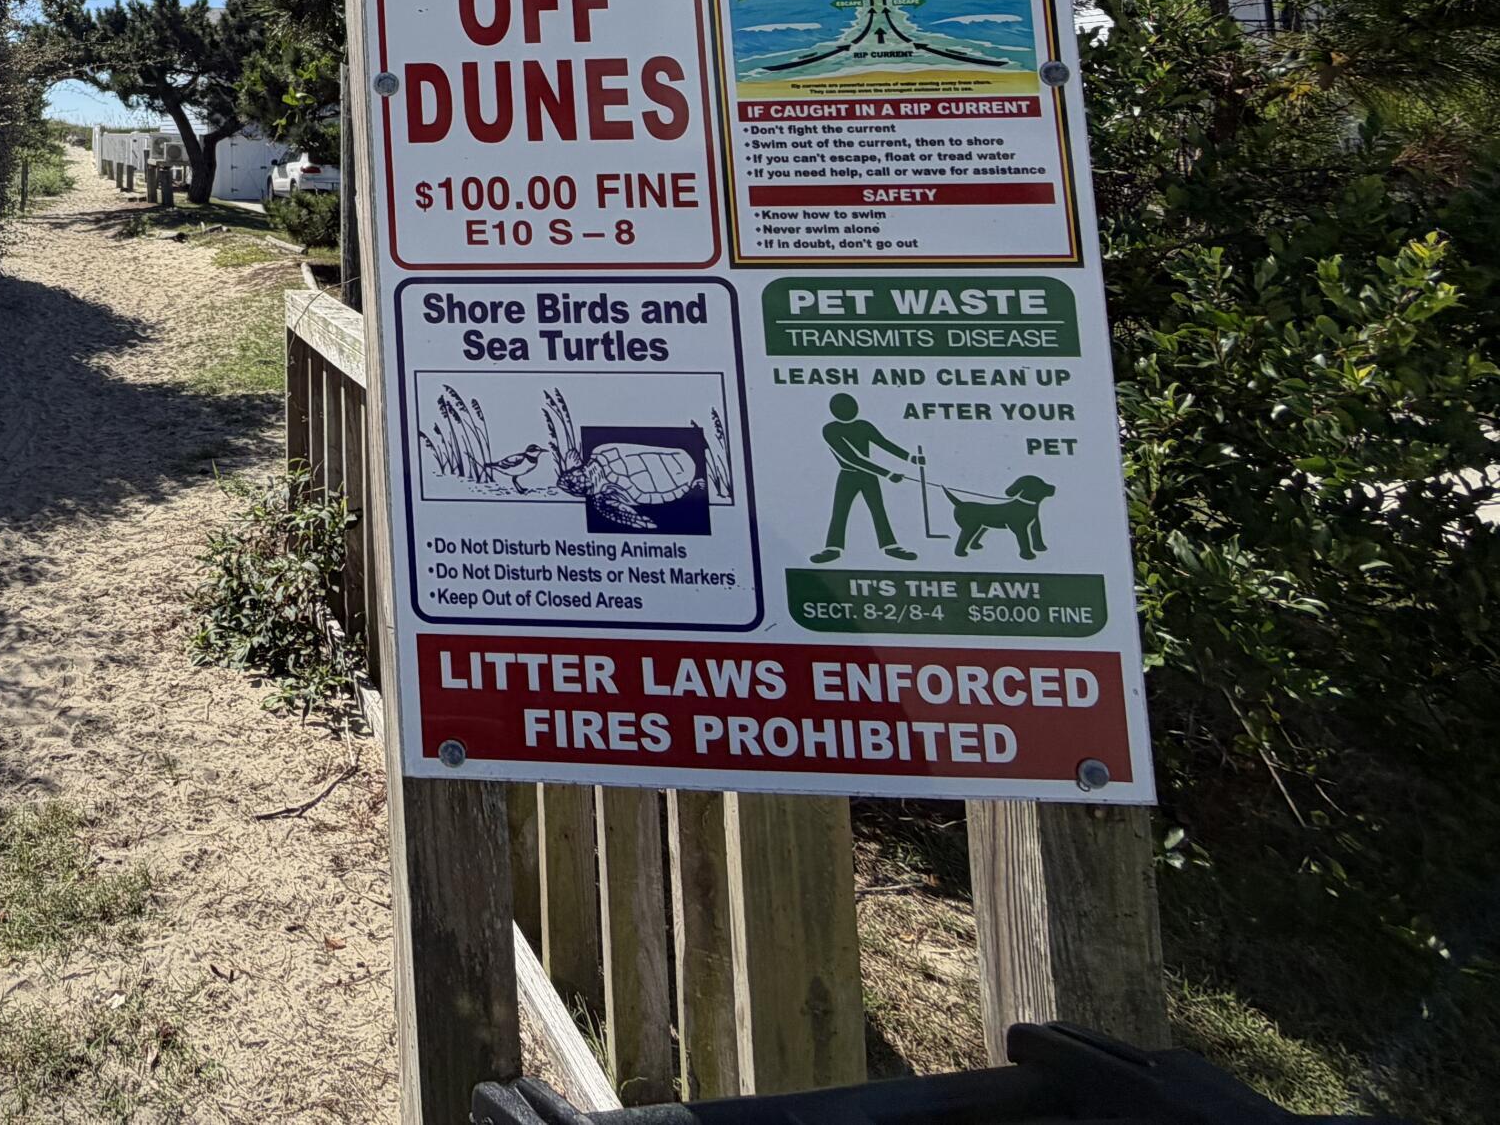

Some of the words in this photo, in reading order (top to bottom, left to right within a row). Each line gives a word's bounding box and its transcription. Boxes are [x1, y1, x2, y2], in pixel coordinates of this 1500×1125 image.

[404, 56, 689, 143] DUNES
[747, 105, 764, 118] IF
[770, 104, 849, 118] CAUGHT
[855, 103, 875, 116] IN
[881, 103, 895, 116] A
[901, 103, 931, 115] RIP
[937, 101, 1030, 114] CURRENT
[751, 125, 784, 134] Don't
[788, 125, 818, 136] fight
[822, 125, 842, 133] the
[847, 124, 896, 133] current
[752, 140, 787, 149] Swim
[791, 140, 812, 148] out
[816, 139, 829, 148] of
[833, 139, 854, 147] the
[858, 138, 912, 148] current,
[915, 137, 945, 146] then
[948, 137, 962, 146] to
[966, 136, 1004, 146] shore
[753, 154, 762, 163] If
[766, 156, 789, 165] you
[793, 154, 825, 163] can't
[830, 154, 881, 164] escape,
[885, 152, 915, 161] float
[919, 153, 933, 161] or
[937, 151, 972, 161] tread
[976, 151, 1016, 160] water
[754, 169, 763, 177] If
[767, 170, 790, 179] you
[794, 168, 825, 177] need
[830, 168, 862, 178] help,
[866, 167, 890, 176] call
[894, 168, 908, 176] or
[911, 168, 946, 176] wave
[950, 166, 969, 175] for
[973, 166, 1046, 175] assistance
[415, 176, 577, 212] $100.00
[596, 173, 698, 209] FINE
[863, 189, 937, 202] SAFETY
[762, 211, 798, 219] Know
[803, 210, 830, 219] how
[834, 211, 847, 219] to
[852, 210, 886, 219] swim
[465, 220, 532, 245] E10
[763, 225, 800, 234] Never
[805, 225, 839, 233] swim
[844, 225, 880, 233] alone
[764, 239, 773, 248] If
[778, 239, 789, 248] in
[793, 239, 835, 249] doubt,
[839, 239, 872, 248] don't
[877, 241, 892, 250] go
[896, 239, 918, 247] out
[423, 294, 525, 323] Shore
[537, 293, 629, 323] Birds
[641, 293, 707, 324] and
[789, 289, 874, 314] PET
[891, 289, 1048, 315] WASTE
[463, 330, 529, 360] Sea
[540, 330, 669, 361] Turtles
[785, 330, 933, 347] TRANSMITS
[948, 329, 1058, 347] DISEASE
[773, 368, 859, 385] LEASH
[872, 368, 925, 386] AND
[936, 368, 1026, 386] CLEAN
[1036, 369, 1071, 386] UP
[903, 403, 992, 420] AFTER
[1000, 403, 1075, 421] YOUR
[1027, 439, 1077, 455] PET
[435, 539, 456, 554] Do
[461, 539, 489, 555] Not
[493, 539, 550, 555] Disturb
[556, 540, 616, 560] Nesting
[620, 541, 687, 558] Animals
[436, 564, 458, 579] Do
[463, 564, 490, 580] Not
[495, 565, 552, 581] Disturb
[557, 565, 602, 582] Nests
[607, 570, 624, 582] or
[628, 567, 665, 584] Nest
[670, 568, 736, 586] Markers
[850, 579, 896, 596] IT'S
[905, 580, 957, 597] THE
[970, 581, 1040, 599] LAW!
[437, 589, 478, 608] Keep
[483, 590, 512, 606] Out
[515, 591, 532, 606] of
[536, 591, 591, 608] Closed
[596, 592, 643, 609] Areas
[803, 603, 857, 619] SECT.
[864, 604, 944, 623] 8-2/8-4
[968, 605, 1040, 623] $50.00
[1048, 606, 1092, 623] FINE
[439, 651, 619, 694] LITTER
[642, 657, 786, 701] LAWS
[812, 661, 1099, 709] ENFORCED
[523, 708, 671, 753] FIRES
[696, 715, 1018, 764] PROHIBITED
